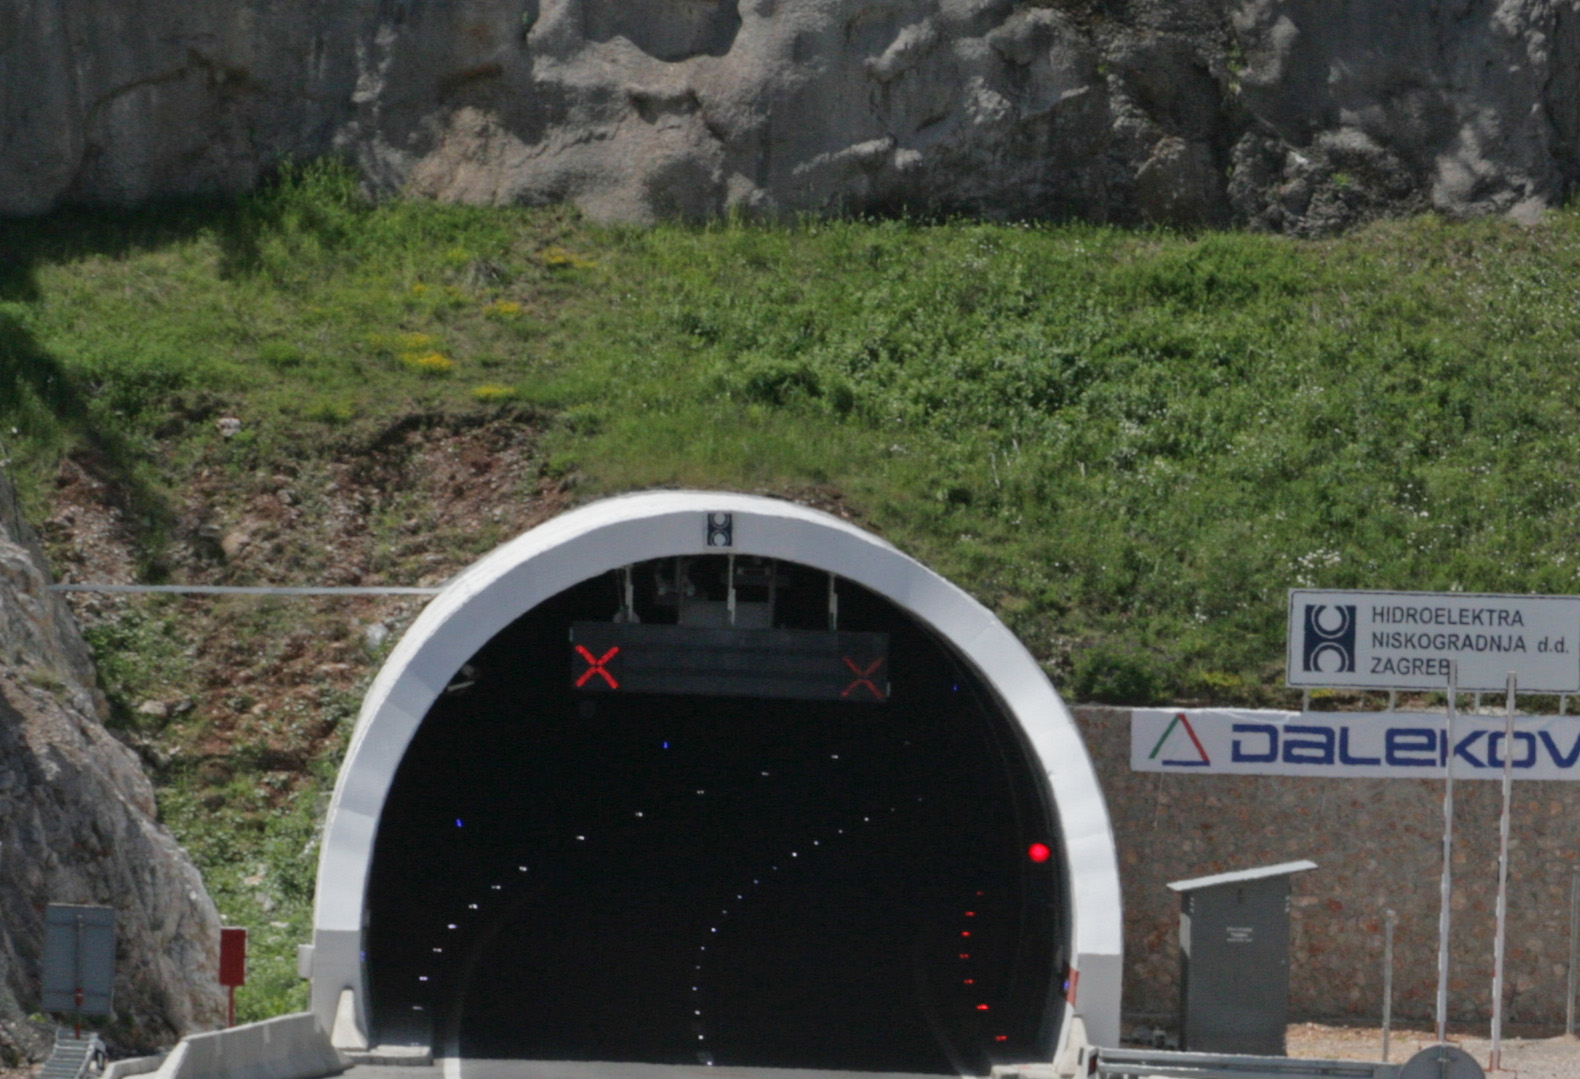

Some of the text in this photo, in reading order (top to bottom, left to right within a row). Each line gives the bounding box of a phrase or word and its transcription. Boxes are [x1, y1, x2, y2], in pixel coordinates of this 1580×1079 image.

[1371, 605, 1525, 627] HIDROELEKTRA
[1371, 631, 1570, 654] NISKOGRADNJA d.d.
[1370, 656, 1451, 676] ZAGREB
